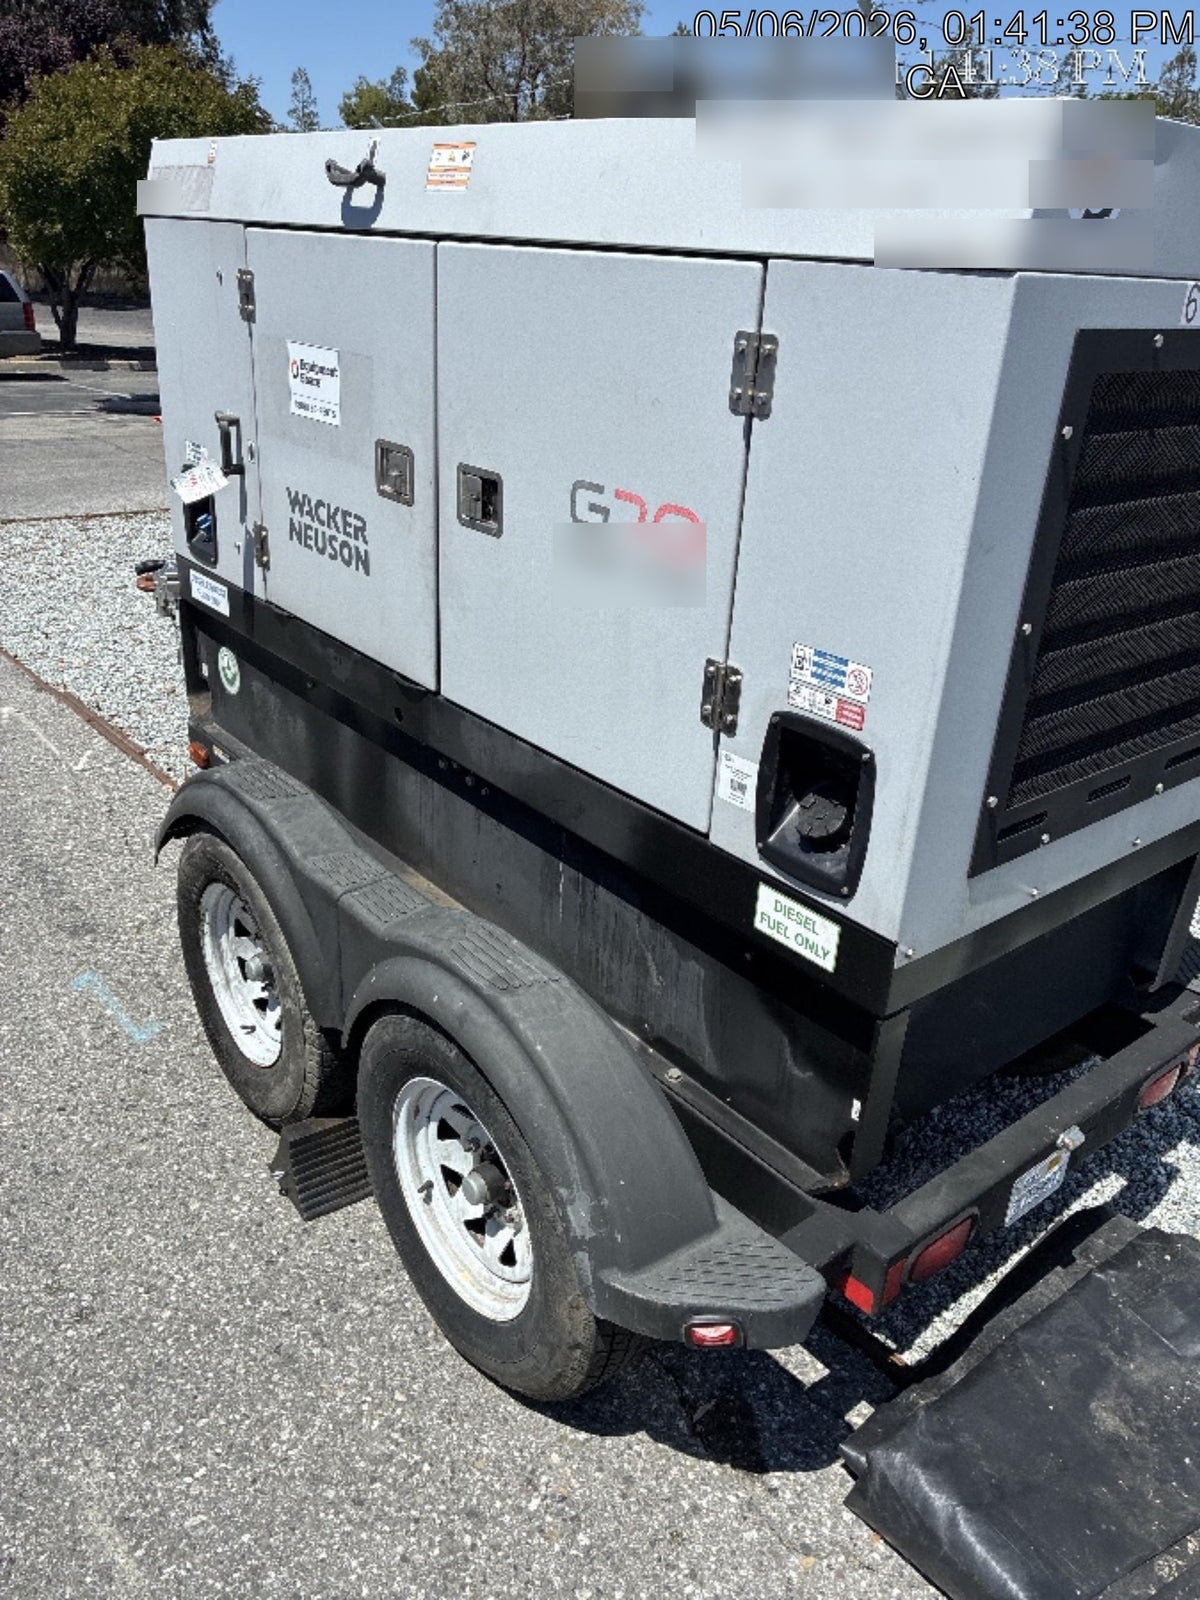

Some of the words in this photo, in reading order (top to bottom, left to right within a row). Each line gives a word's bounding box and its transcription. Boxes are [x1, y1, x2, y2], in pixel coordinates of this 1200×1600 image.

[285, 486, 369, 547] WACKER
[288, 516, 371, 577] NEUSON
[759, 910, 791, 940] FUEL
[794, 932, 831, 961] ONLY
[774, 899, 820, 936] DIESEL
